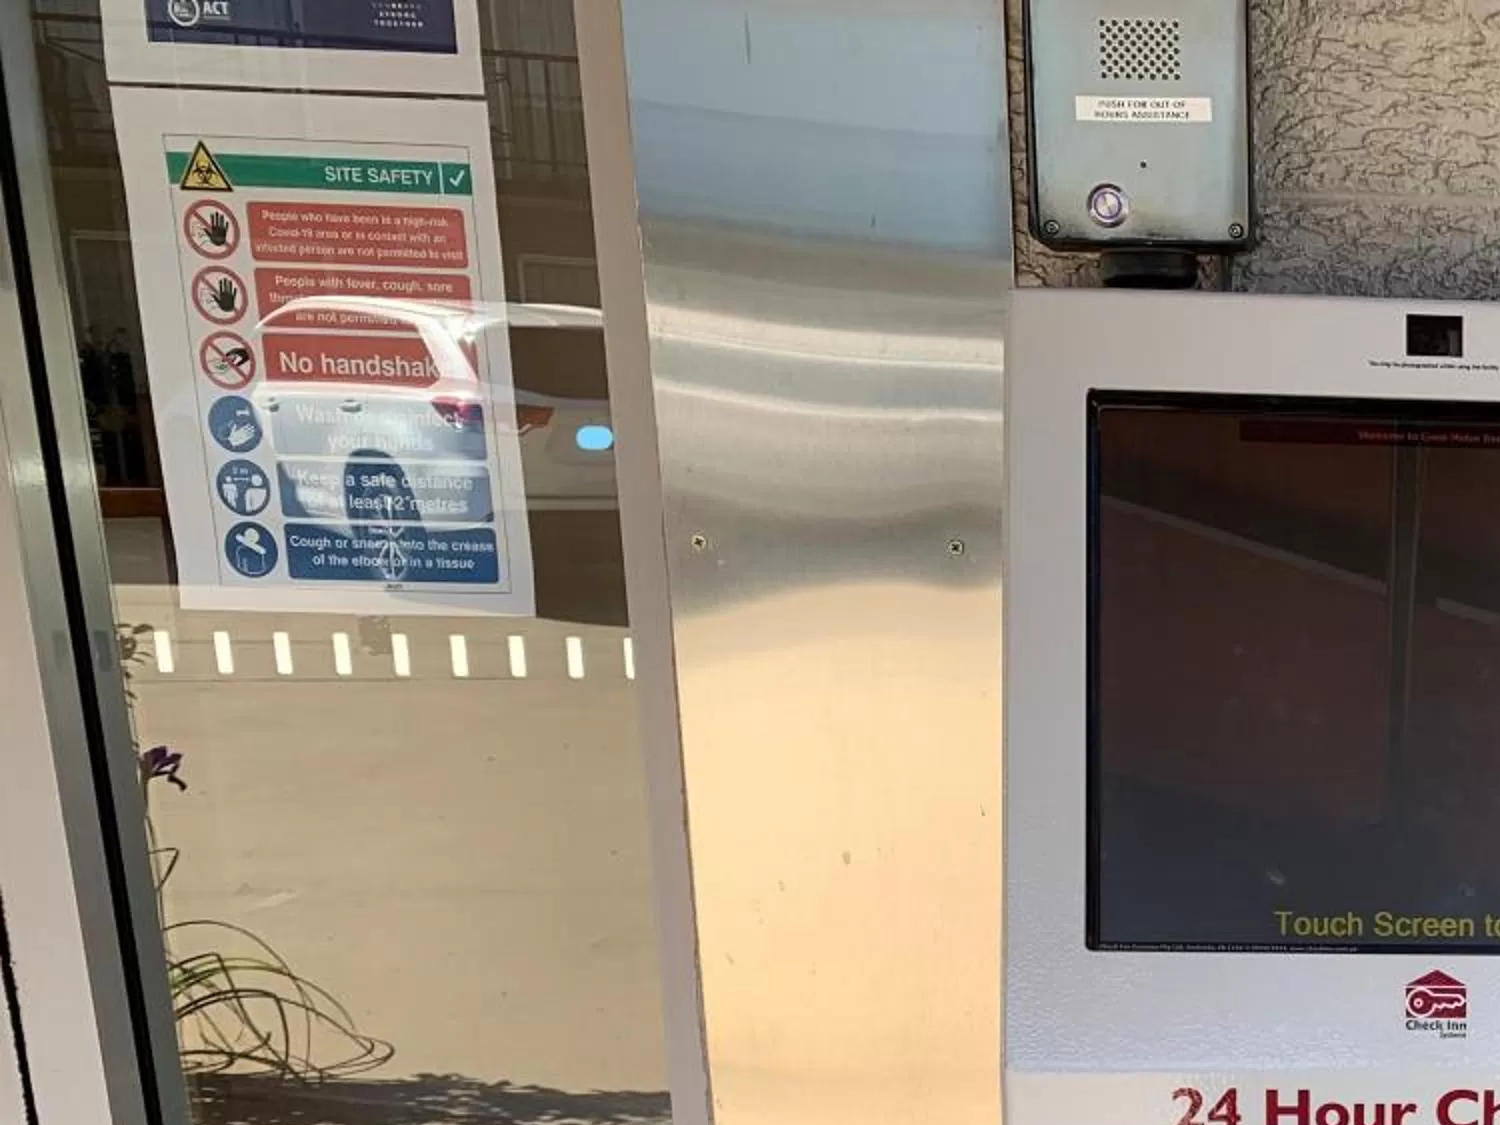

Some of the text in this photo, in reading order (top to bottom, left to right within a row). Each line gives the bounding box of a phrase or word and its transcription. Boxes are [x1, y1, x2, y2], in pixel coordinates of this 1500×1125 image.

[203, 1, 228, 15] ACT
[325, 166, 433, 186] SITE SAFETY
[262, 209, 298, 223] People
[301, 211, 323, 223] who
[325, 212, 350, 224] have
[353, 213, 379, 225] been
[403, 215, 449, 227] high-risk
[268, 226, 313, 238] Covid-19
[315, 229, 339, 240] area
[341, 230, 353, 240] or
[368, 231, 407, 242] contact
[409, 233, 431, 244] with
[433, 235, 447, 244] an
[256, 243, 464, 261] infected person are not permitted to visit
[275, 275, 315, 289] People
[318, 277, 343, 289] with
[427, 283, 453, 293] sore
[317, 312, 337, 323] not
[279, 351, 440, 378] No handshak
[346, 477, 355, 487] a
[360, 473, 396, 487] safe
[401, 473, 473, 490] distance
[394, 497, 405, 511] 2
[410, 497, 469, 512] metres
[289, 535, 331, 550] Cough
[335, 539, 348, 549] or
[427, 539, 448, 551] the
[451, 541, 495, 553] crease
[311, 555, 325, 566] of
[327, 555, 348, 566] the
[409, 557, 421, 568] in
[436, 557, 475, 570] tissue
[1274, 911, 1363, 937] Touch
[1373, 911, 1475, 938] Screen
[1405, 1019, 1467, 1031] Check Inn
